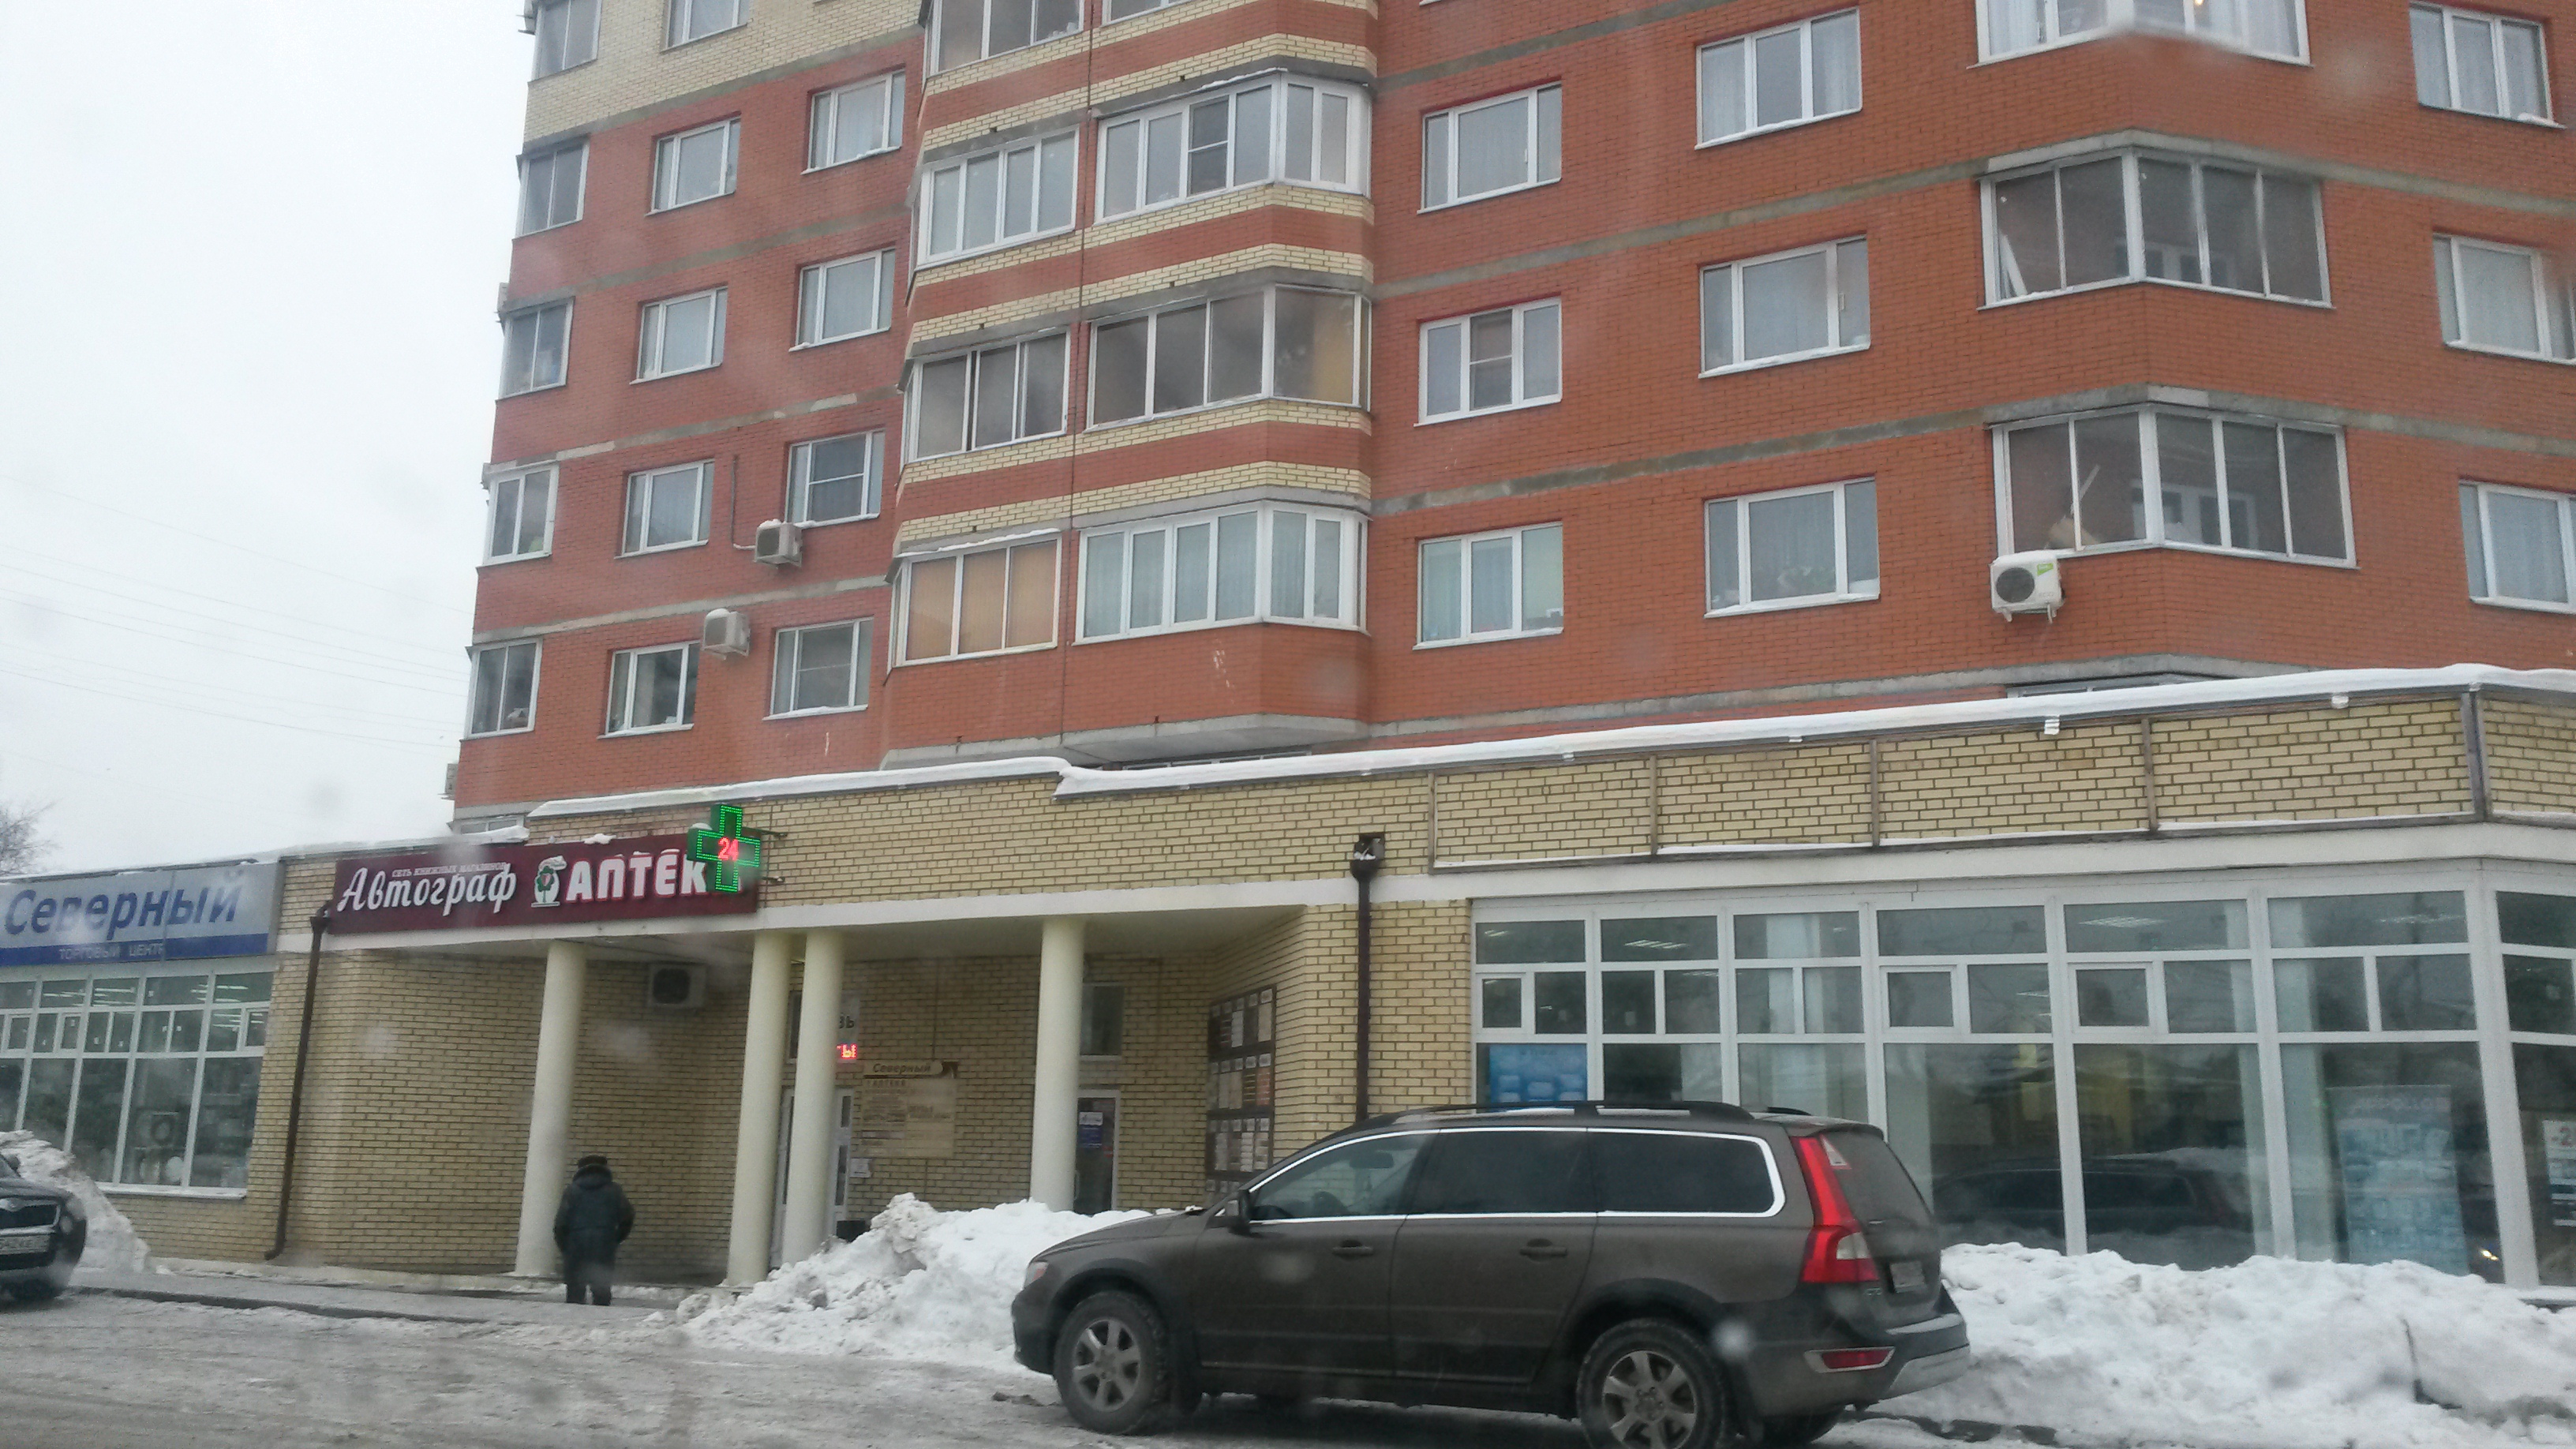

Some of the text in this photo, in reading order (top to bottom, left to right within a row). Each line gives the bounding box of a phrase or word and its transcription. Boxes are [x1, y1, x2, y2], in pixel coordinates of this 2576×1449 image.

[717, 836, 739, 862] 24
[336, 863, 517, 915] Автограф
[565, 853, 743, 902] АПТЕК
[5, 869, 243, 940] Северный
[873, 1062, 931, 1074] Северный
